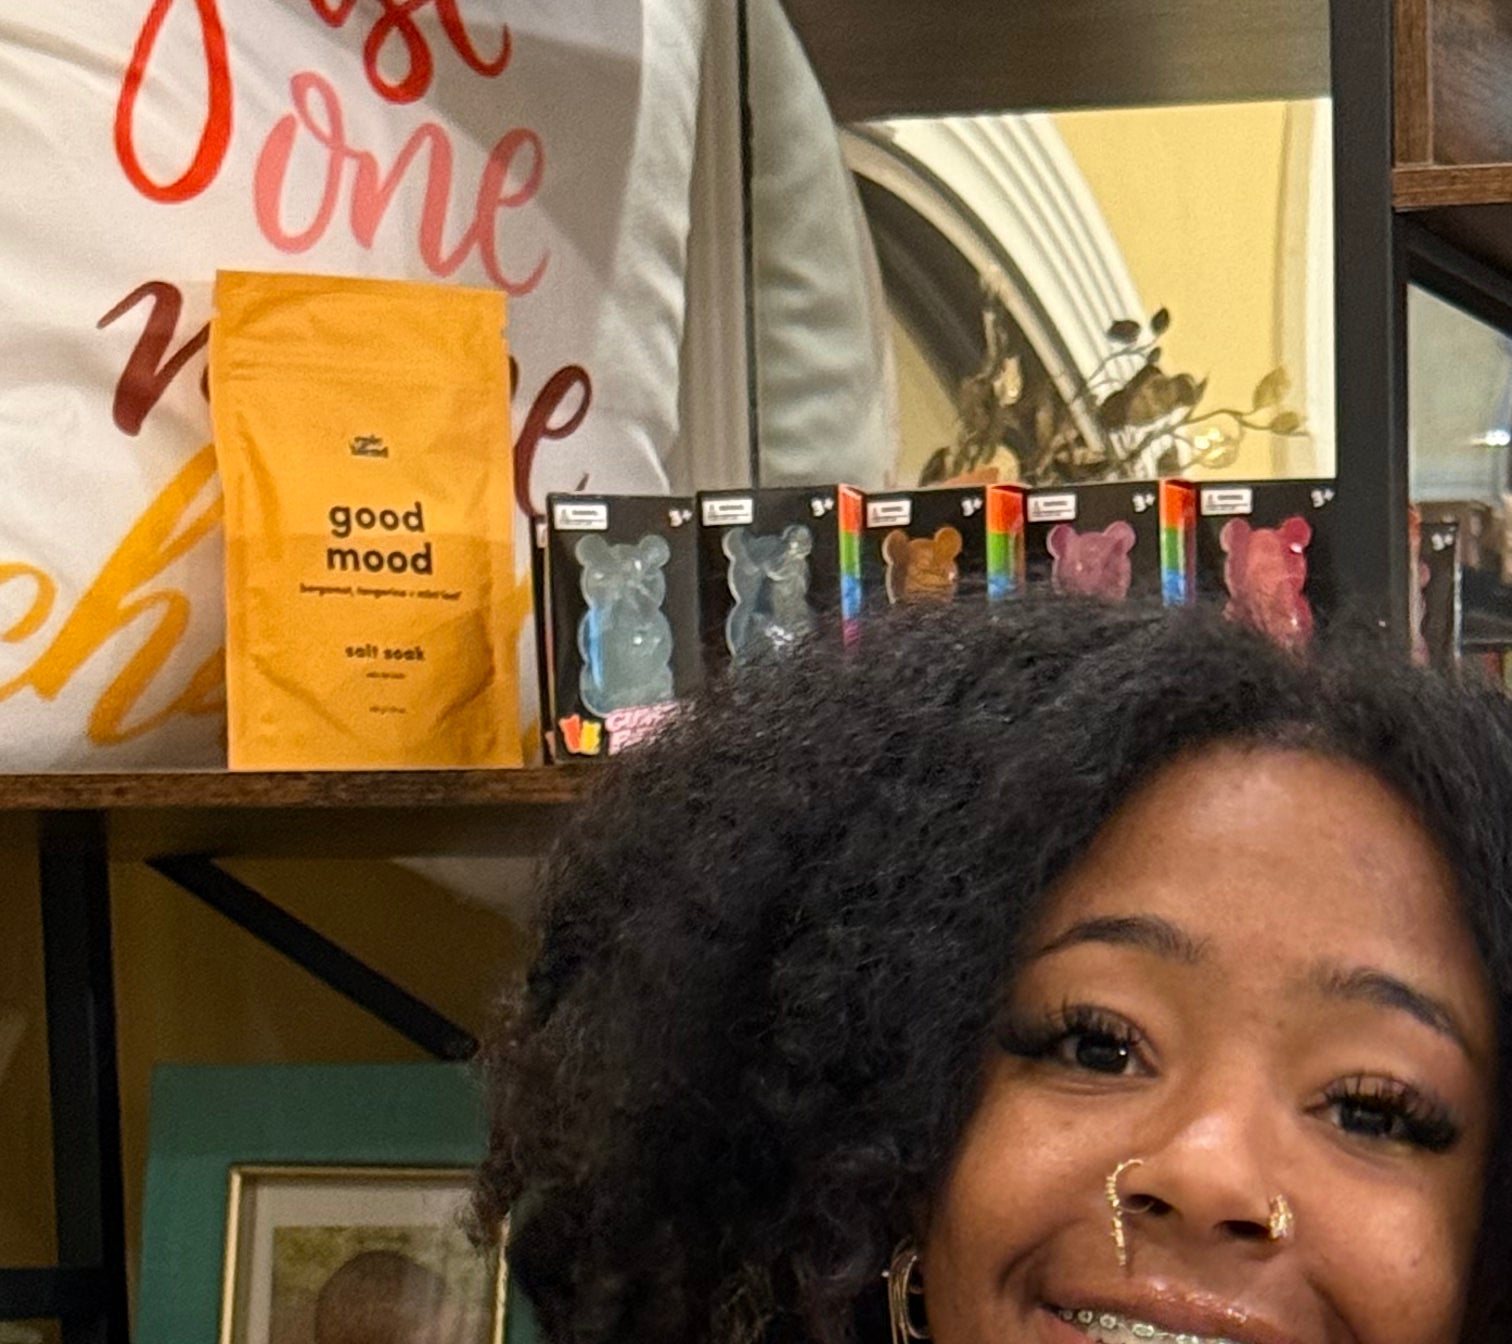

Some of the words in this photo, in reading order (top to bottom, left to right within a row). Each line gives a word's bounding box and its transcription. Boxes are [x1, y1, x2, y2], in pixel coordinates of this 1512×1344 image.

[254, 70, 551, 296] one
[328, 501, 425, 538] good
[326, 542, 433, 575] mood
[345, 644, 378, 658] salt
[384, 647, 424, 660] soak
